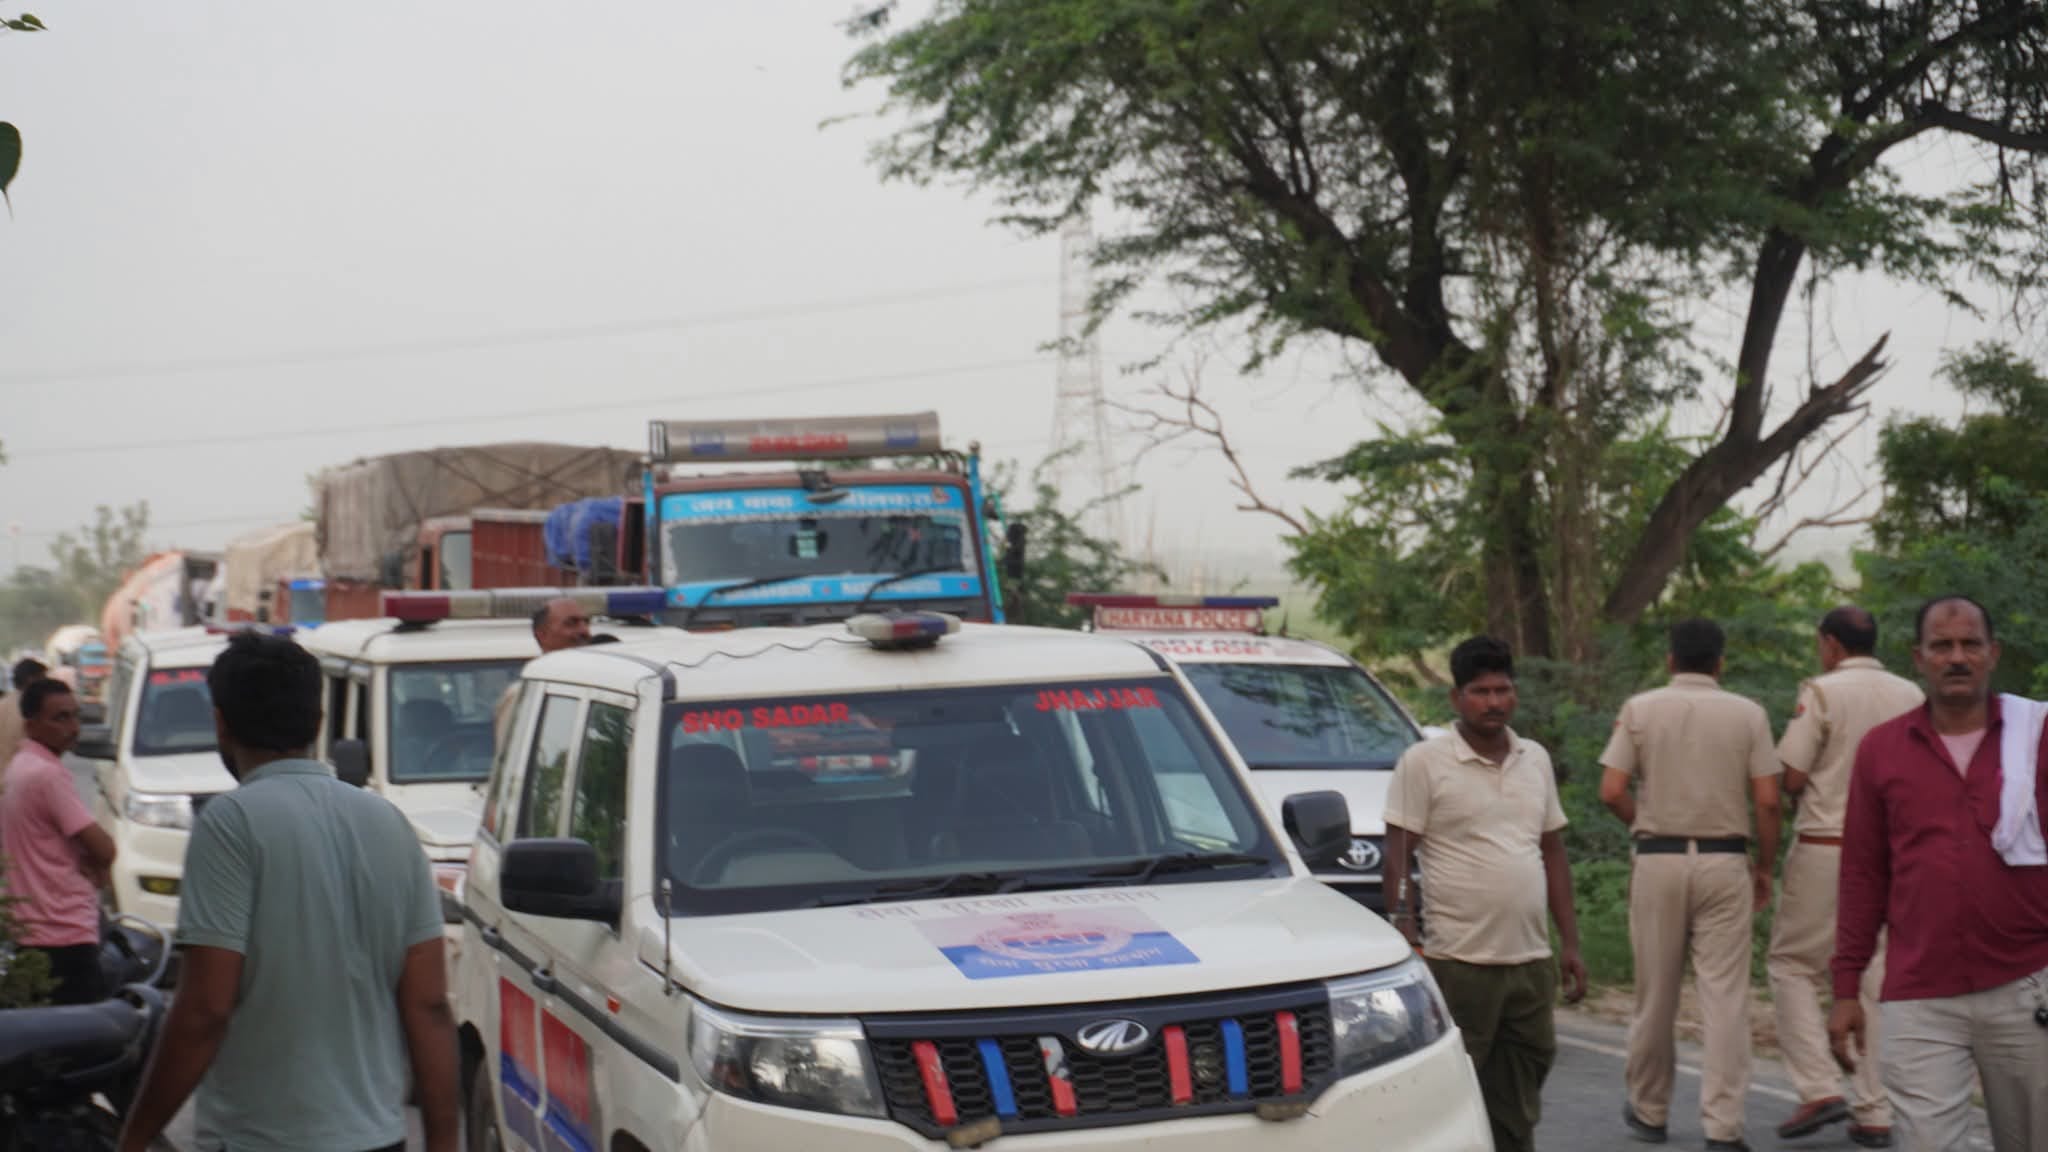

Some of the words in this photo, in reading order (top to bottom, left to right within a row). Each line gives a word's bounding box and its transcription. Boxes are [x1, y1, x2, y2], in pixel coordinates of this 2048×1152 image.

[1109, 611, 1186, 626] HARYANA
[1191, 610, 1249, 629] POLICE
[1034, 686, 1163, 713] JHAJJAR
[682, 708, 744, 735] SHO
[751, 702, 849, 729] SADAR
